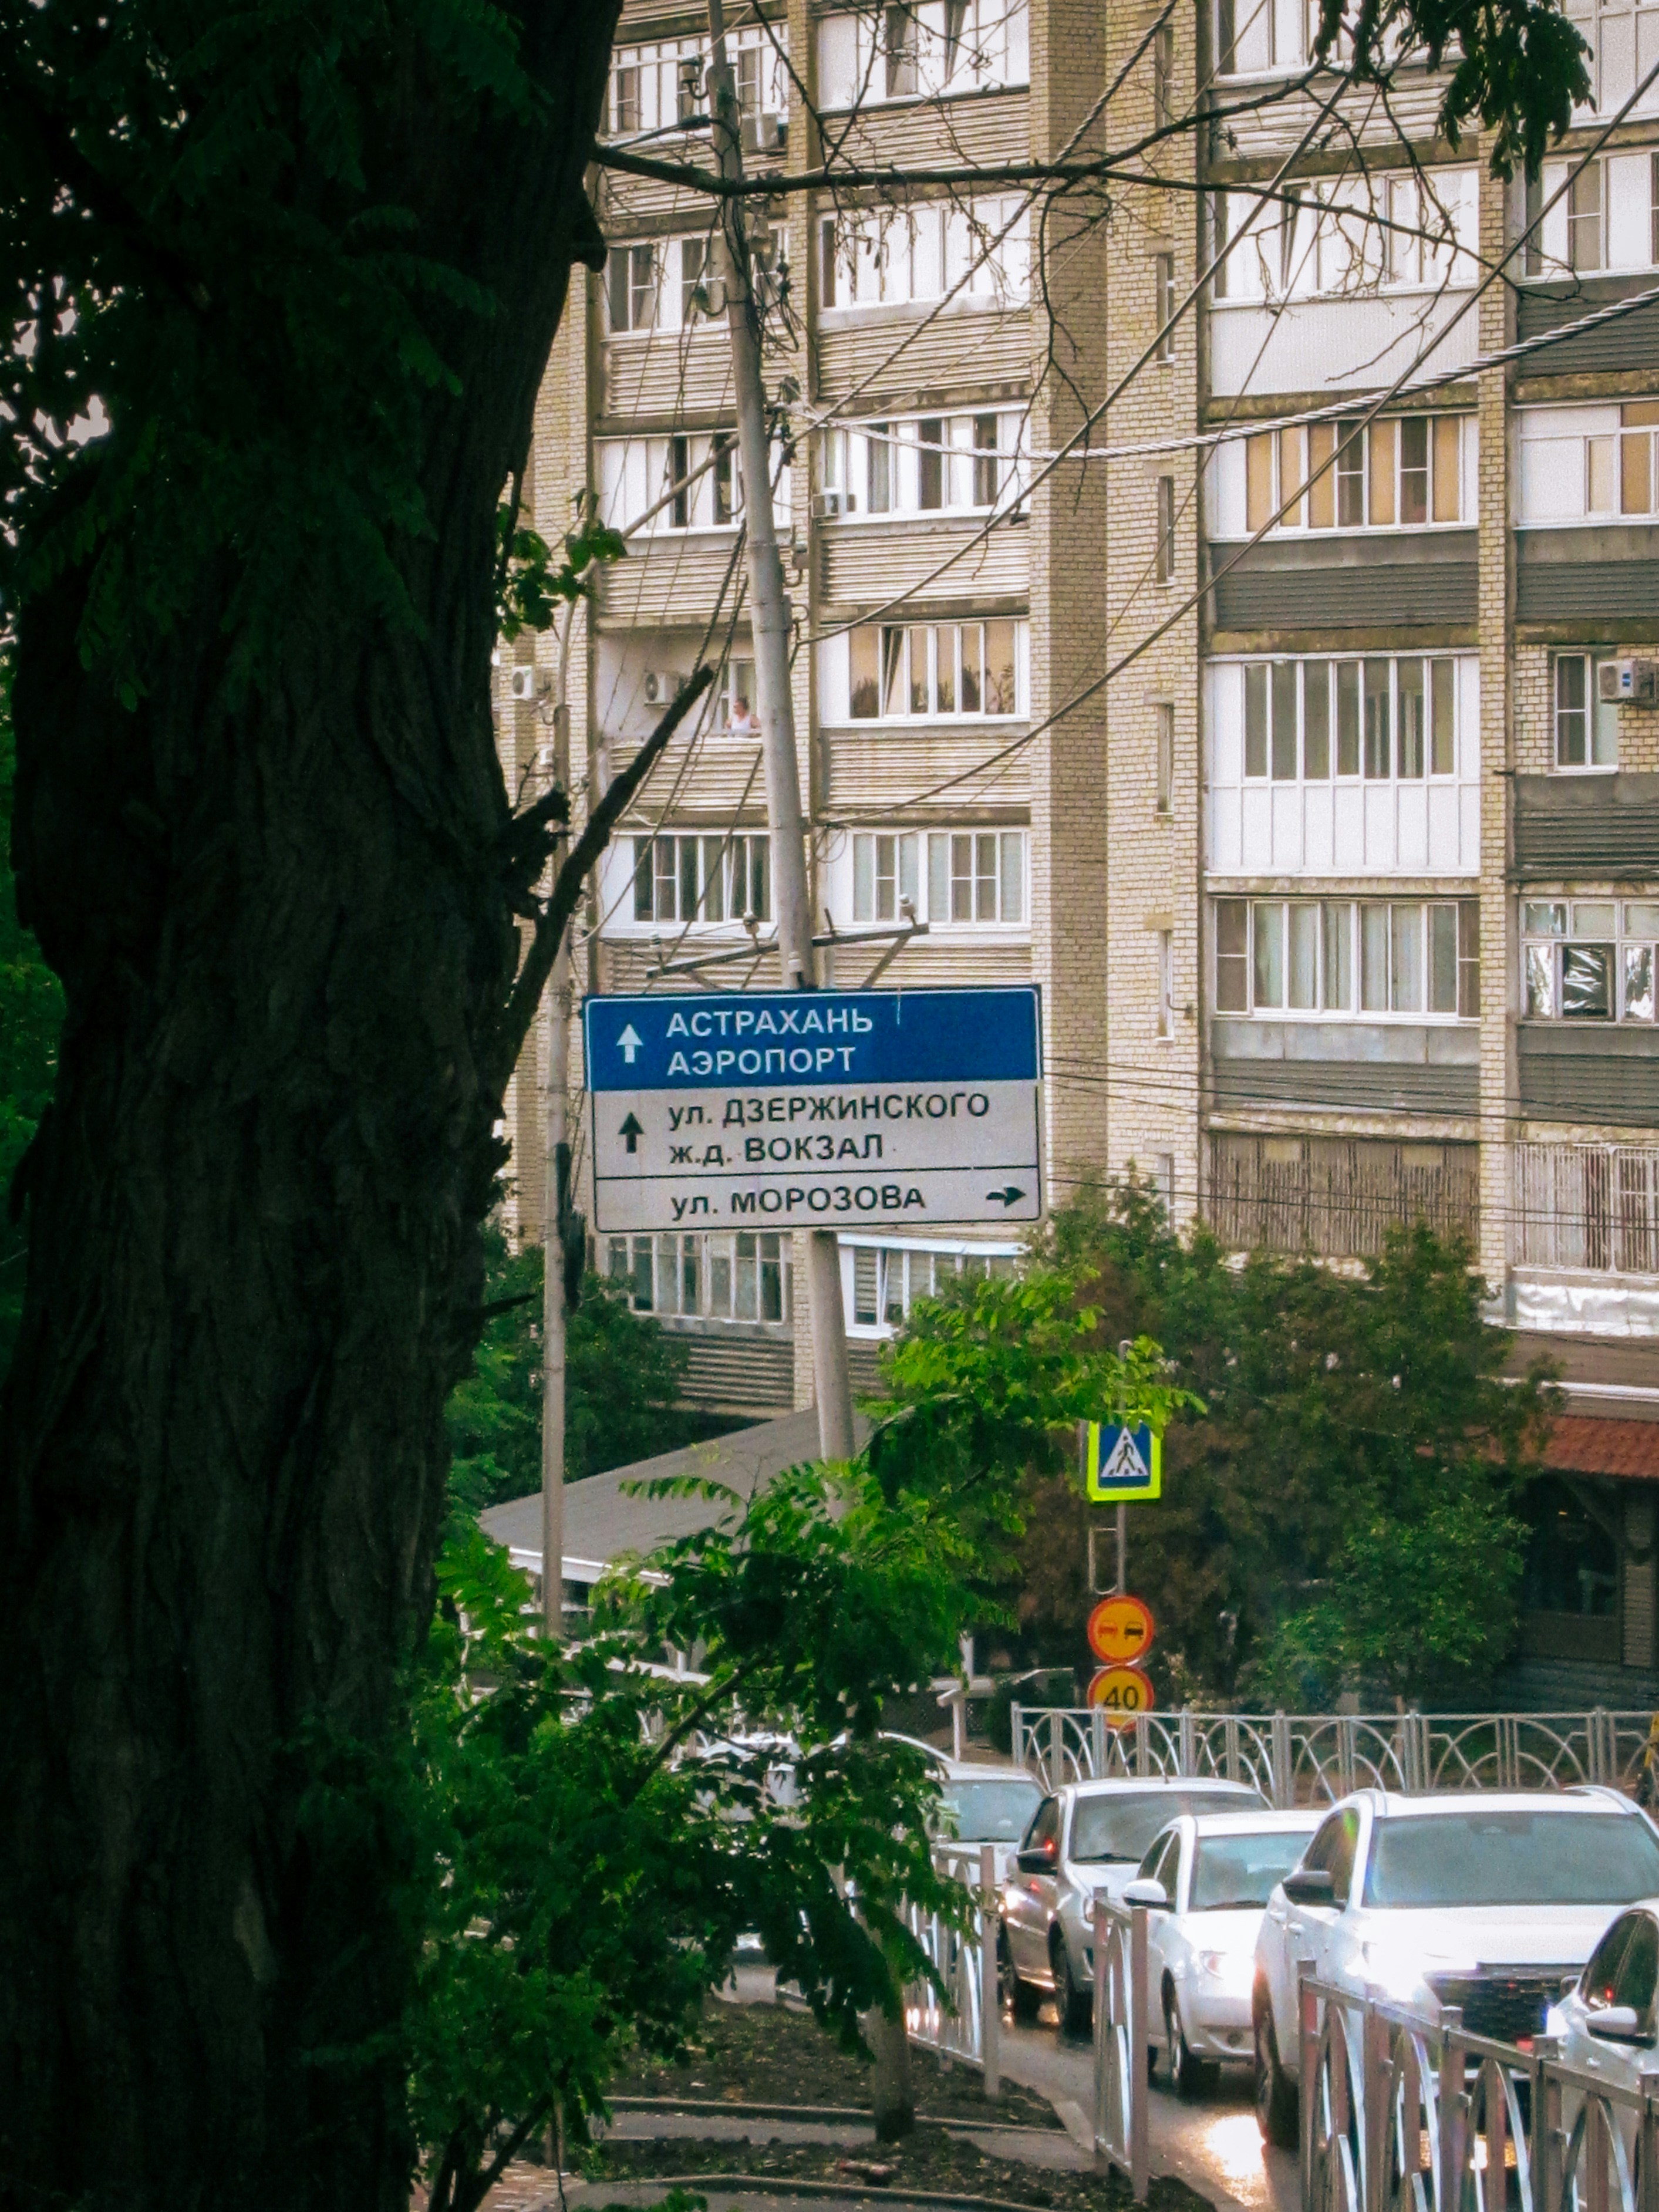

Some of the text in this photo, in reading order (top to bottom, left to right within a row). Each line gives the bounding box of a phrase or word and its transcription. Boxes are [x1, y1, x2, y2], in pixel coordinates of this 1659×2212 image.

[667, 1008, 873, 1038] АСТРАХАНЬ
[667, 1047, 857, 1077] АЭРОПОРТ
[668, 1092, 990, 1132] ул. ДЗЕРЖИНСКОГО
[669, 1134, 884, 1167] ж.д. ВОКЗАЛ
[672, 1185, 926, 1222] ул. МОРОЗОВА
[1104, 1685, 1139, 1711] 40
